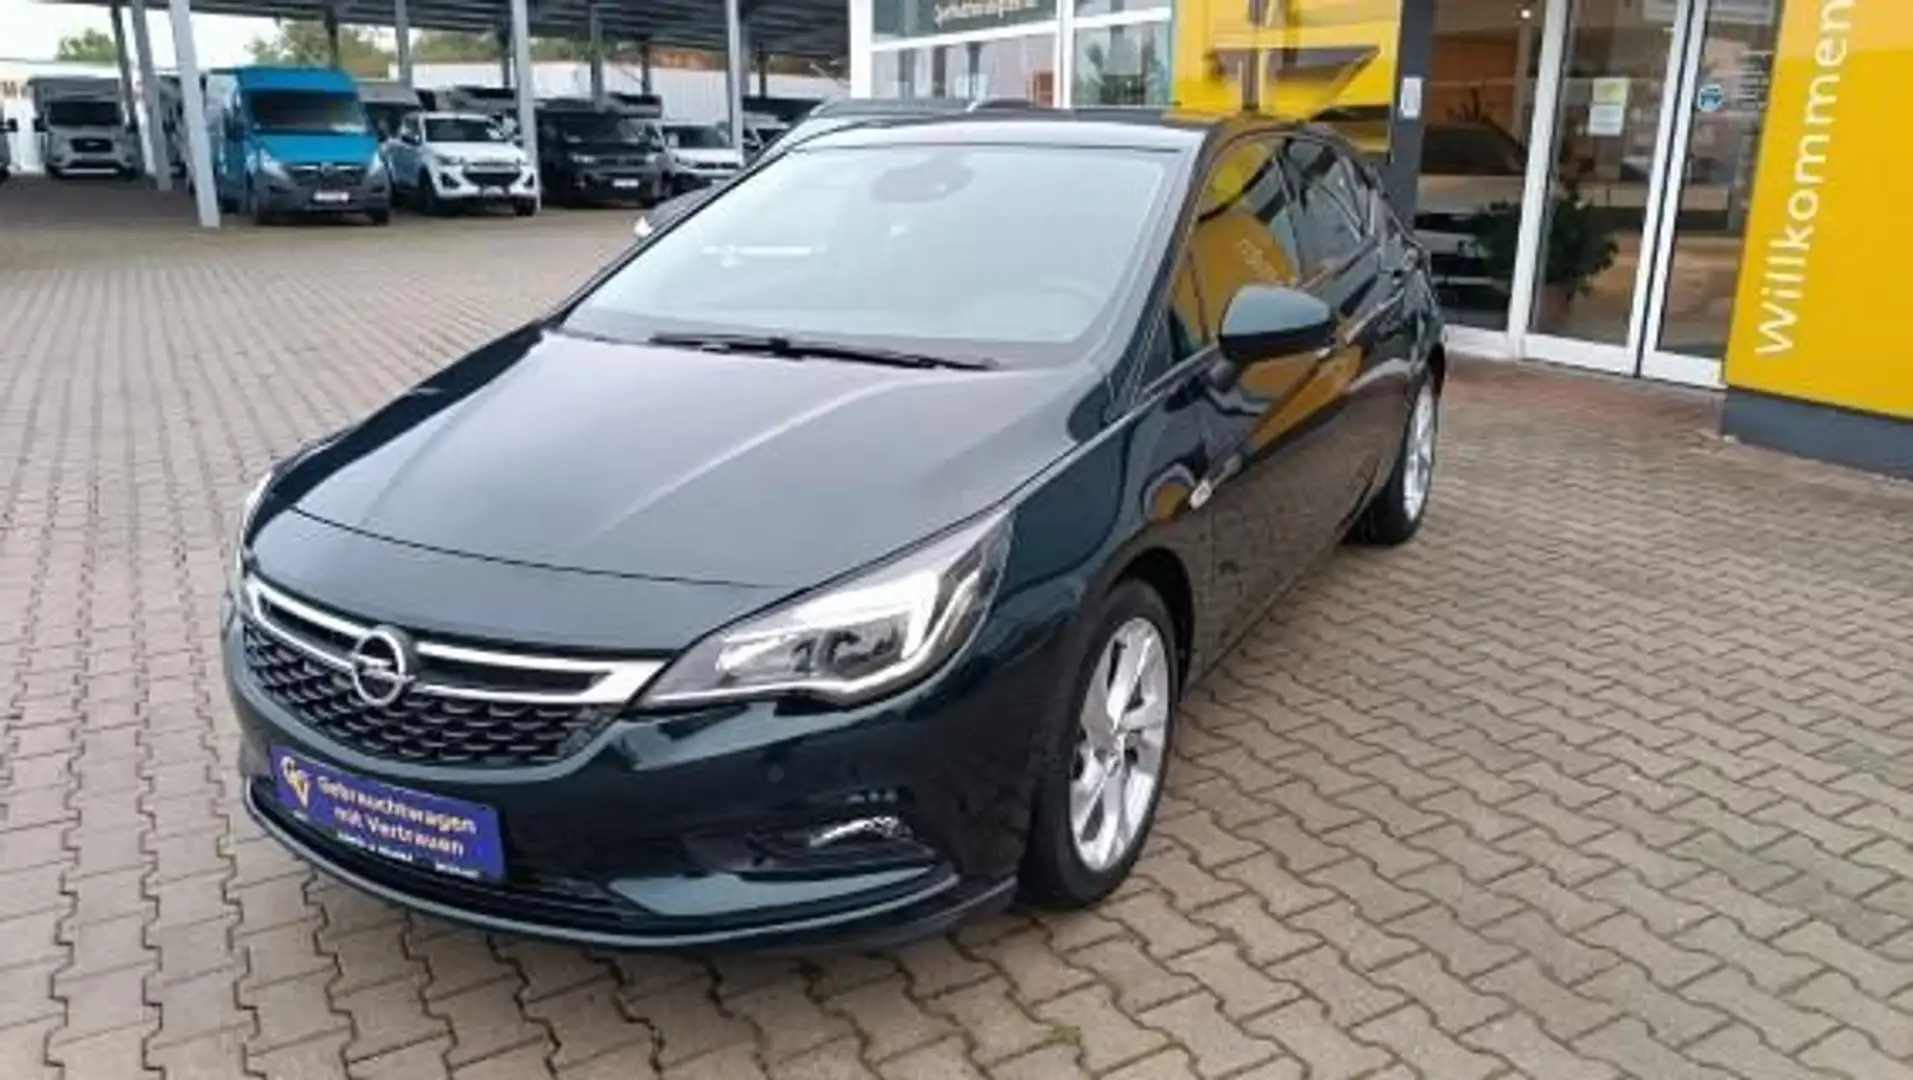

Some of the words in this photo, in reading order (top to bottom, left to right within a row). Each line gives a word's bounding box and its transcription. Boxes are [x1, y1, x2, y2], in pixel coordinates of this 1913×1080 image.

[1755, 0, 1853, 356] Willkommen
[316, 775, 478, 834] Gebrauchtwagen
[333, 805, 364, 829] mit
[364, 814, 465, 858] Vertrauen
